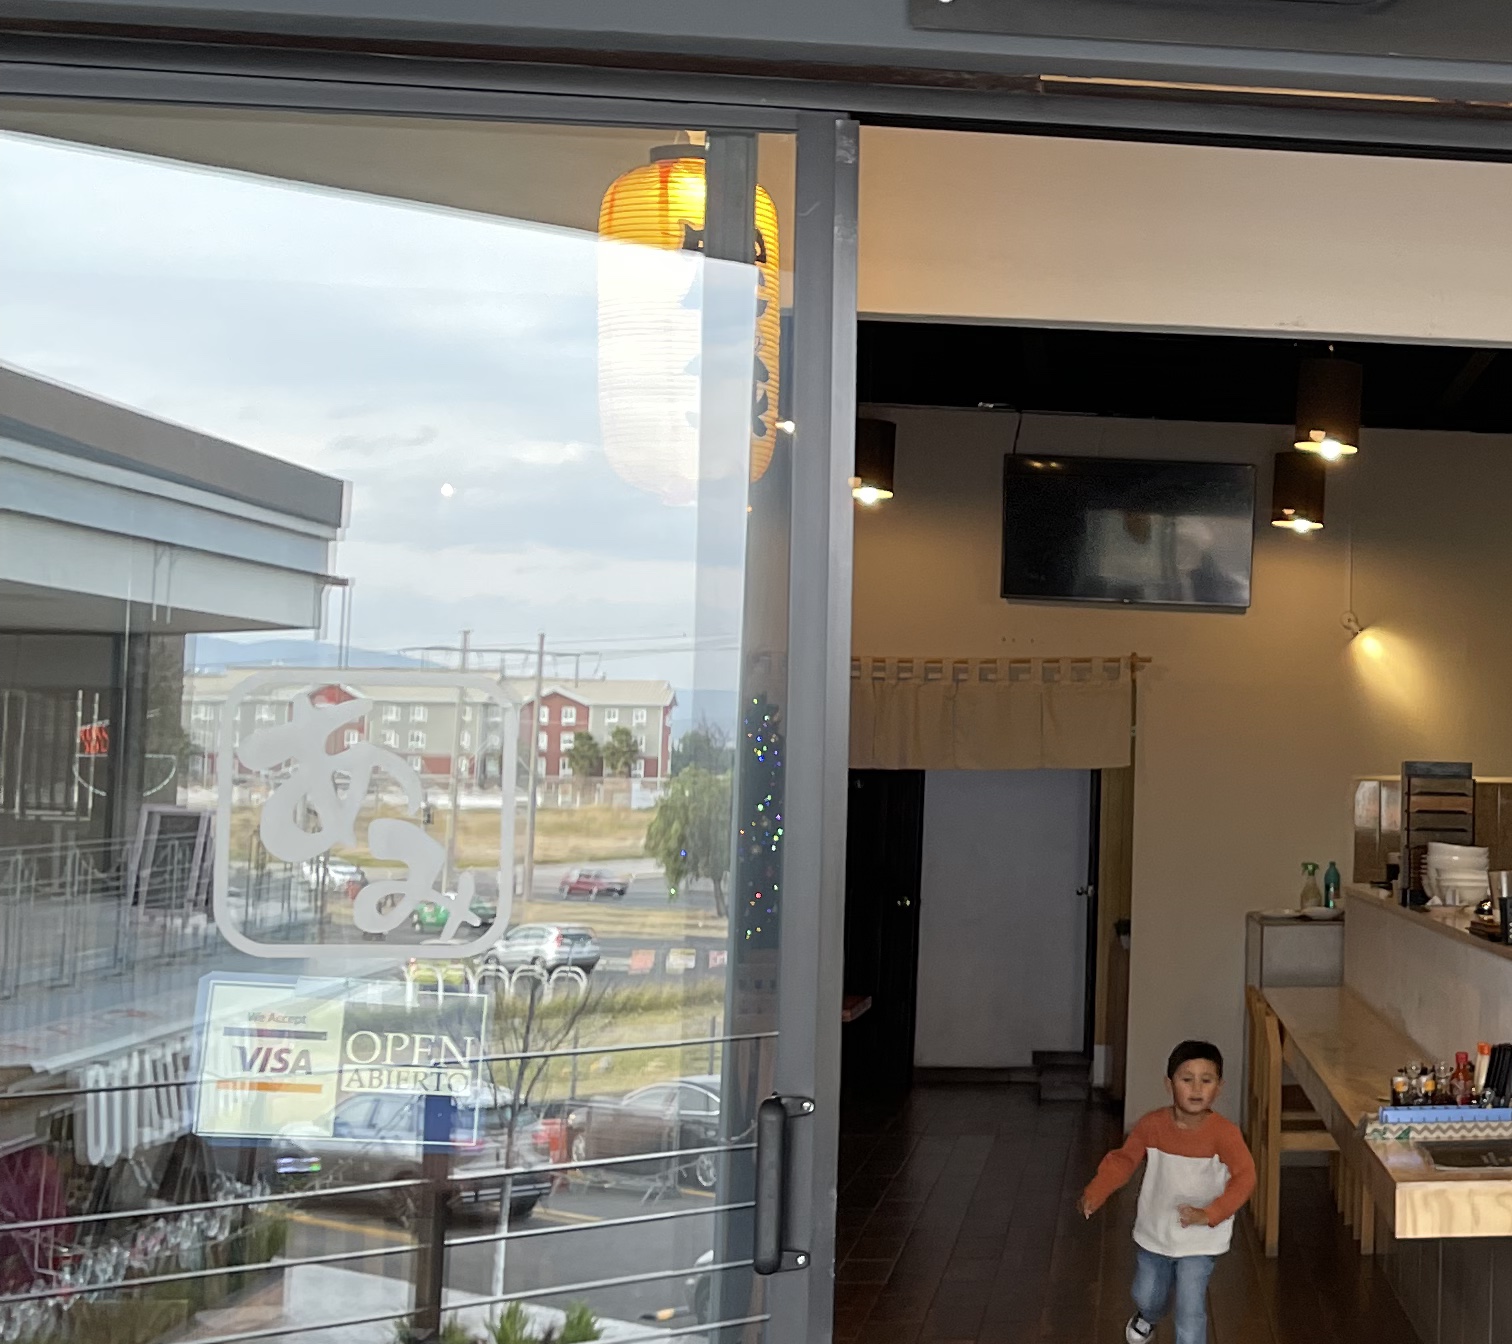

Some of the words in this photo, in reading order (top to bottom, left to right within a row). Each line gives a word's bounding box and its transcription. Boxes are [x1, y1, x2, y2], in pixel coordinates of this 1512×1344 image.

[237, 691, 482, 943] あみ
[248, 1012, 267, 1025] We
[268, 1013, 307, 1026] Accept
[234, 1046, 312, 1076] VISA
[346, 1029, 475, 1069] OPEN
[345, 1068, 470, 1093] ABIERTO
